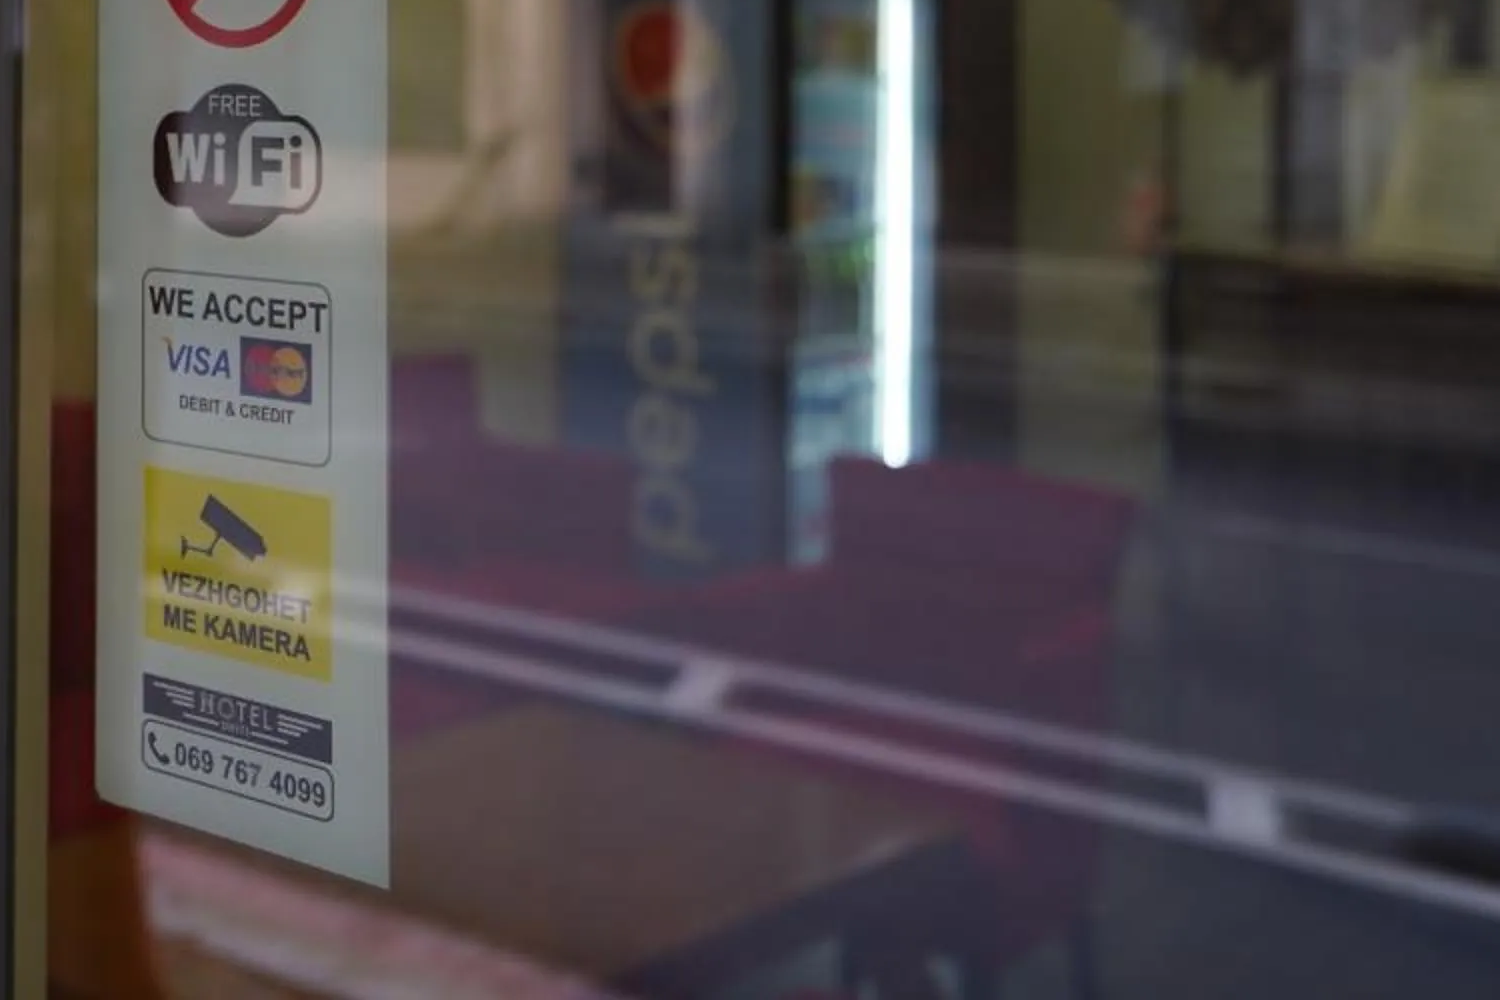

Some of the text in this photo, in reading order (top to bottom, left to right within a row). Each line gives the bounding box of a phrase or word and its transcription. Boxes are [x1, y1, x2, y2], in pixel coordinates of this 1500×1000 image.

[208, 95, 262, 118] FREE
[148, 285, 328, 333] WE ACCEPT
[161, 335, 231, 380] VISA
[179, 393, 295, 425] DEBIT & CREDIT
[161, 567, 312, 625] VEZHGOHET
[163, 603, 312, 662] ME KAMERA
[200, 691, 274, 731] HOTEL
[174, 742, 326, 808] 069 767 4099
